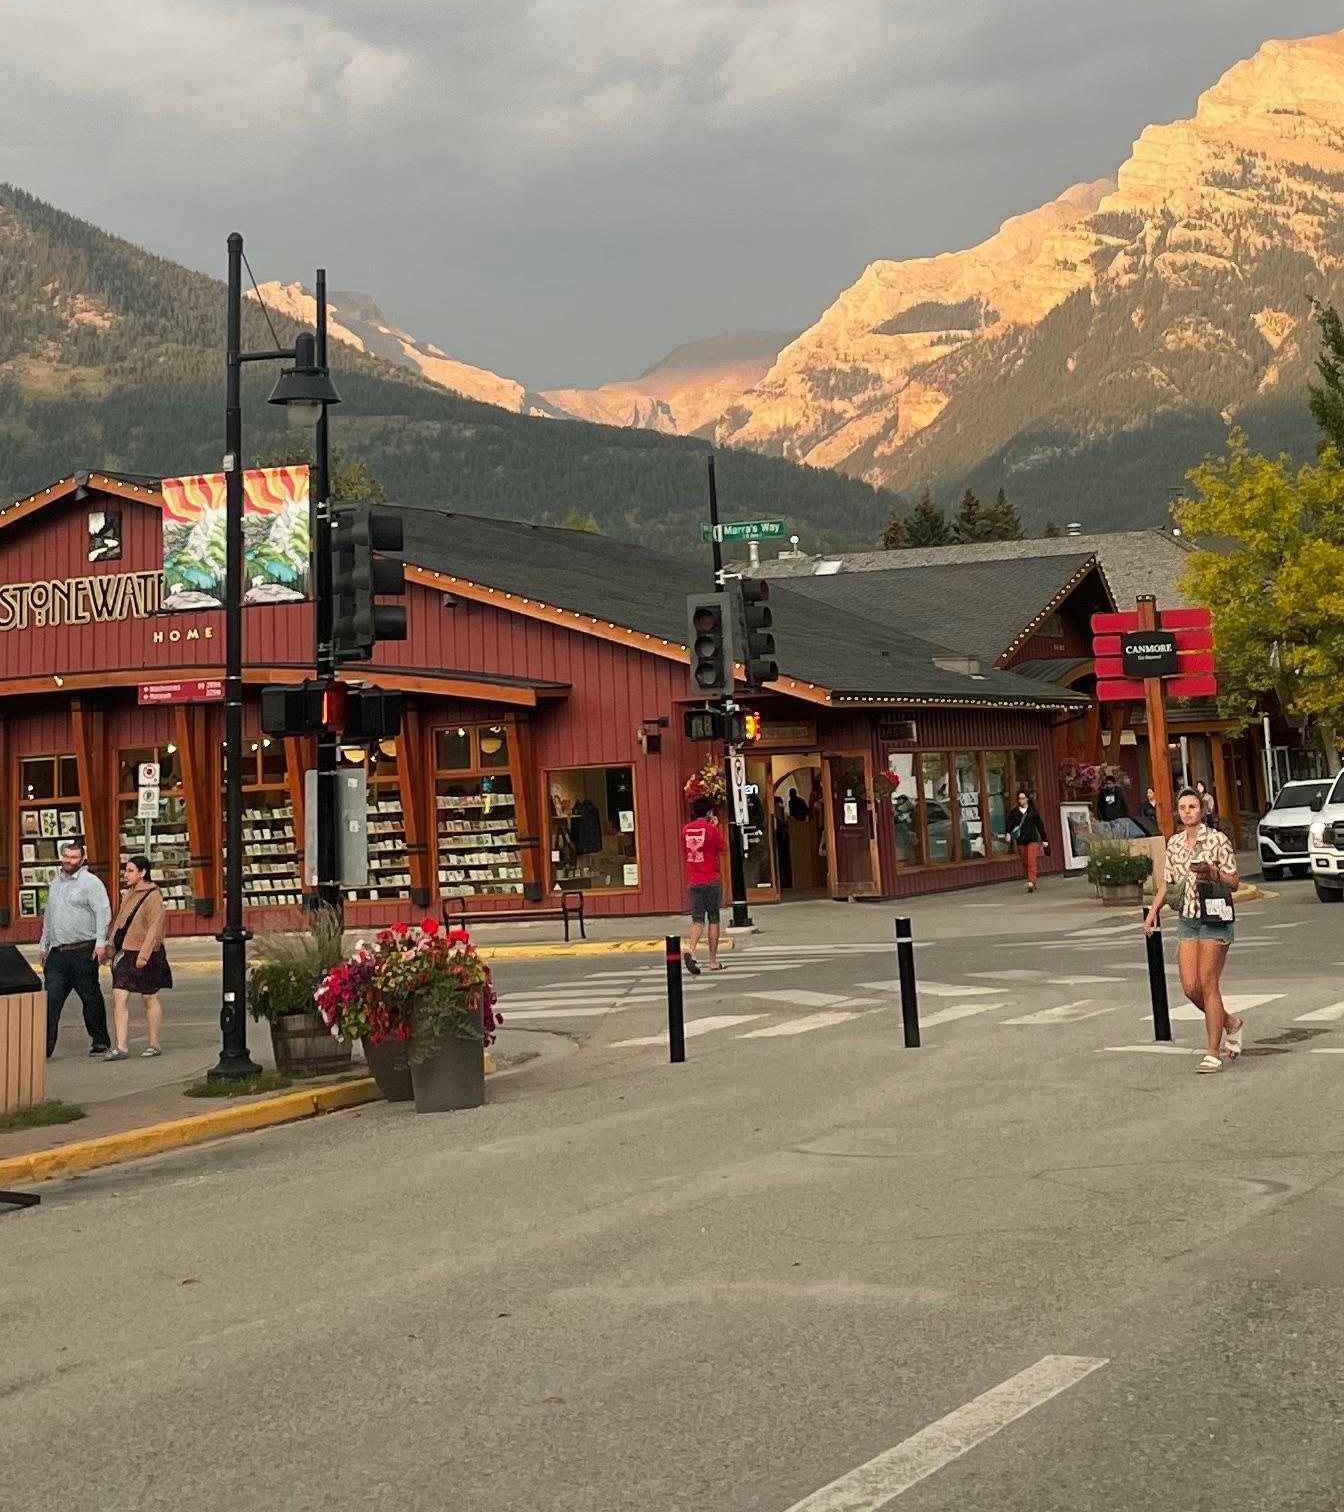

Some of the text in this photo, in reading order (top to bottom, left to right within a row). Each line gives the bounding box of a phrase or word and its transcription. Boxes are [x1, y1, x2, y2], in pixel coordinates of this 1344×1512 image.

[724, 522, 780, 535] Marra's Way
[154, 627, 213, 644] HOME
[1125, 643, 1173, 655] CANMORE
